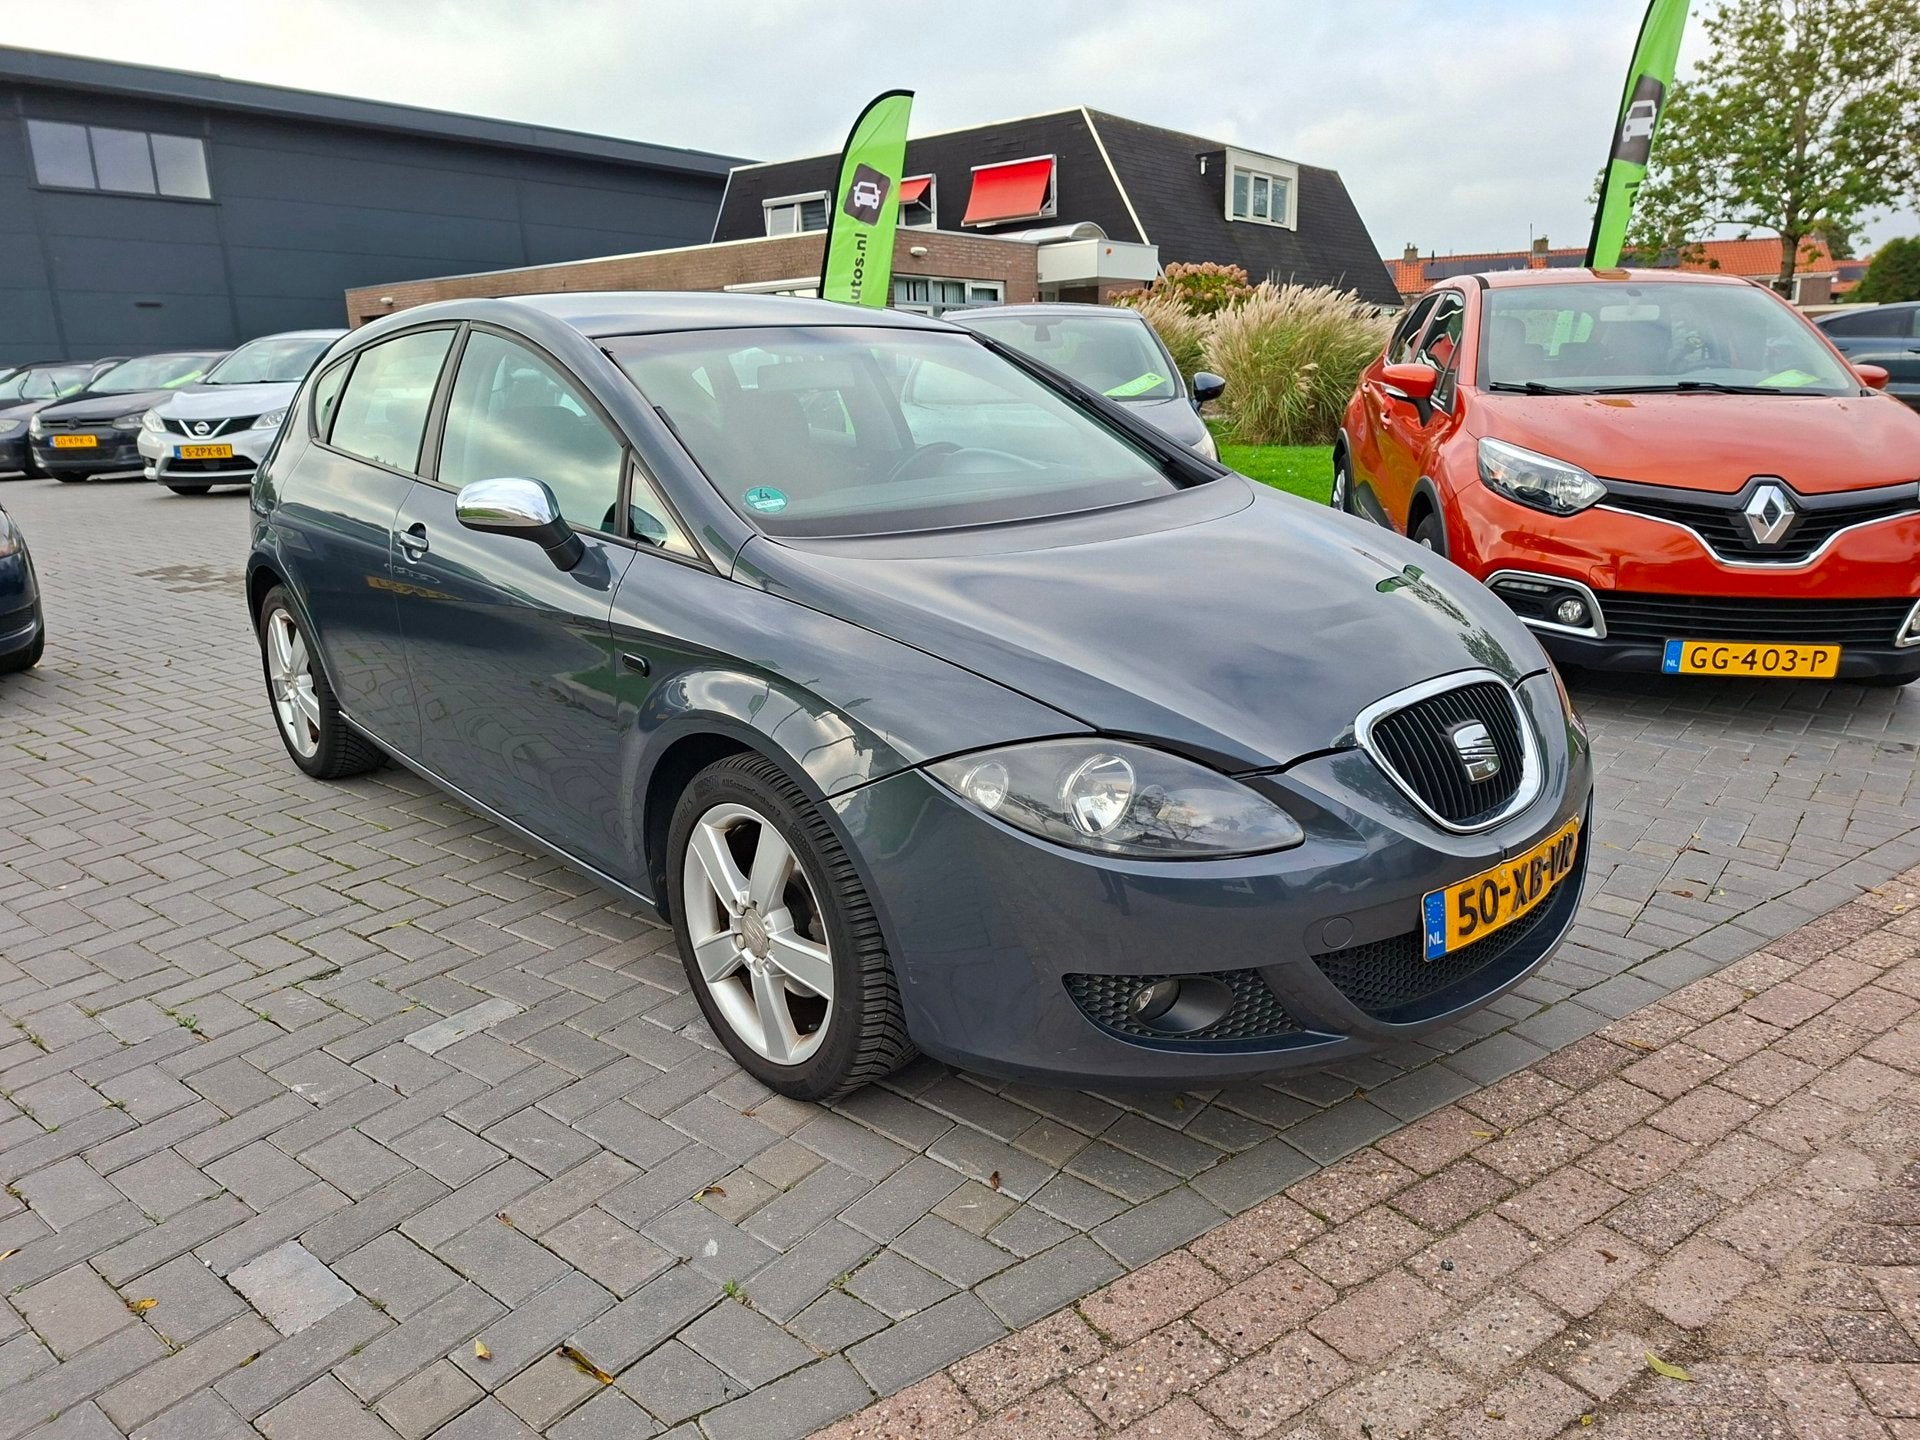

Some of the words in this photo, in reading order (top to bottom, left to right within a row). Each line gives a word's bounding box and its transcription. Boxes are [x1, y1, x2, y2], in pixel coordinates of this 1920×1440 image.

[850, 232, 868, 303] utos.nl
[185, 446, 227, 457] 5-ZPX-81
[1666, 659, 1678, 667] NL
[1690, 646, 1829, 672] GG-403-P
[1428, 933, 1443, 947] NL
[1458, 831, 1575, 936] 50-XB-VR
